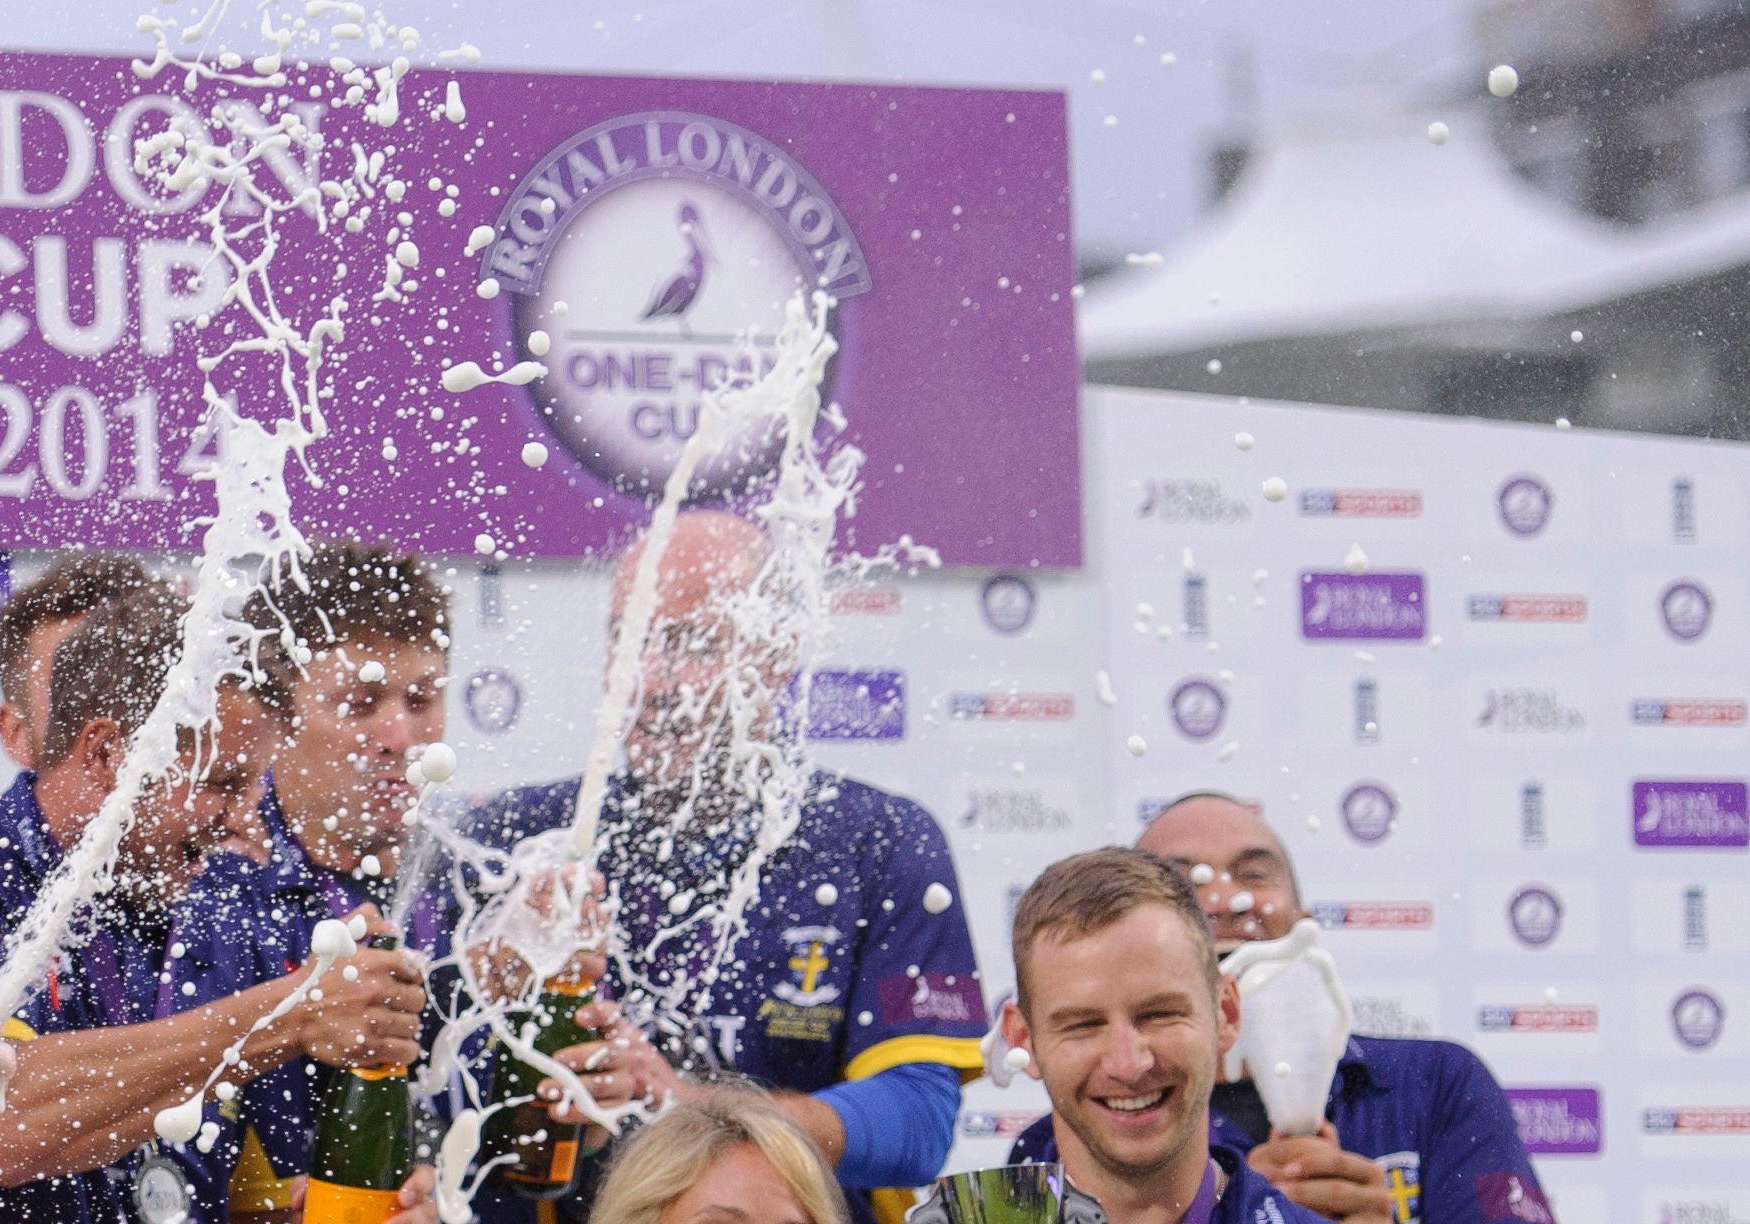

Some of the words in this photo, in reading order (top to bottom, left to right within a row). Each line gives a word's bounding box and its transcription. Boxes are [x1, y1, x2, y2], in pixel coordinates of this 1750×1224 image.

[491, 133, 637, 284] ROYAL
[646, 121, 863, 292] LONDON
[633, 404, 698, 440] CU
